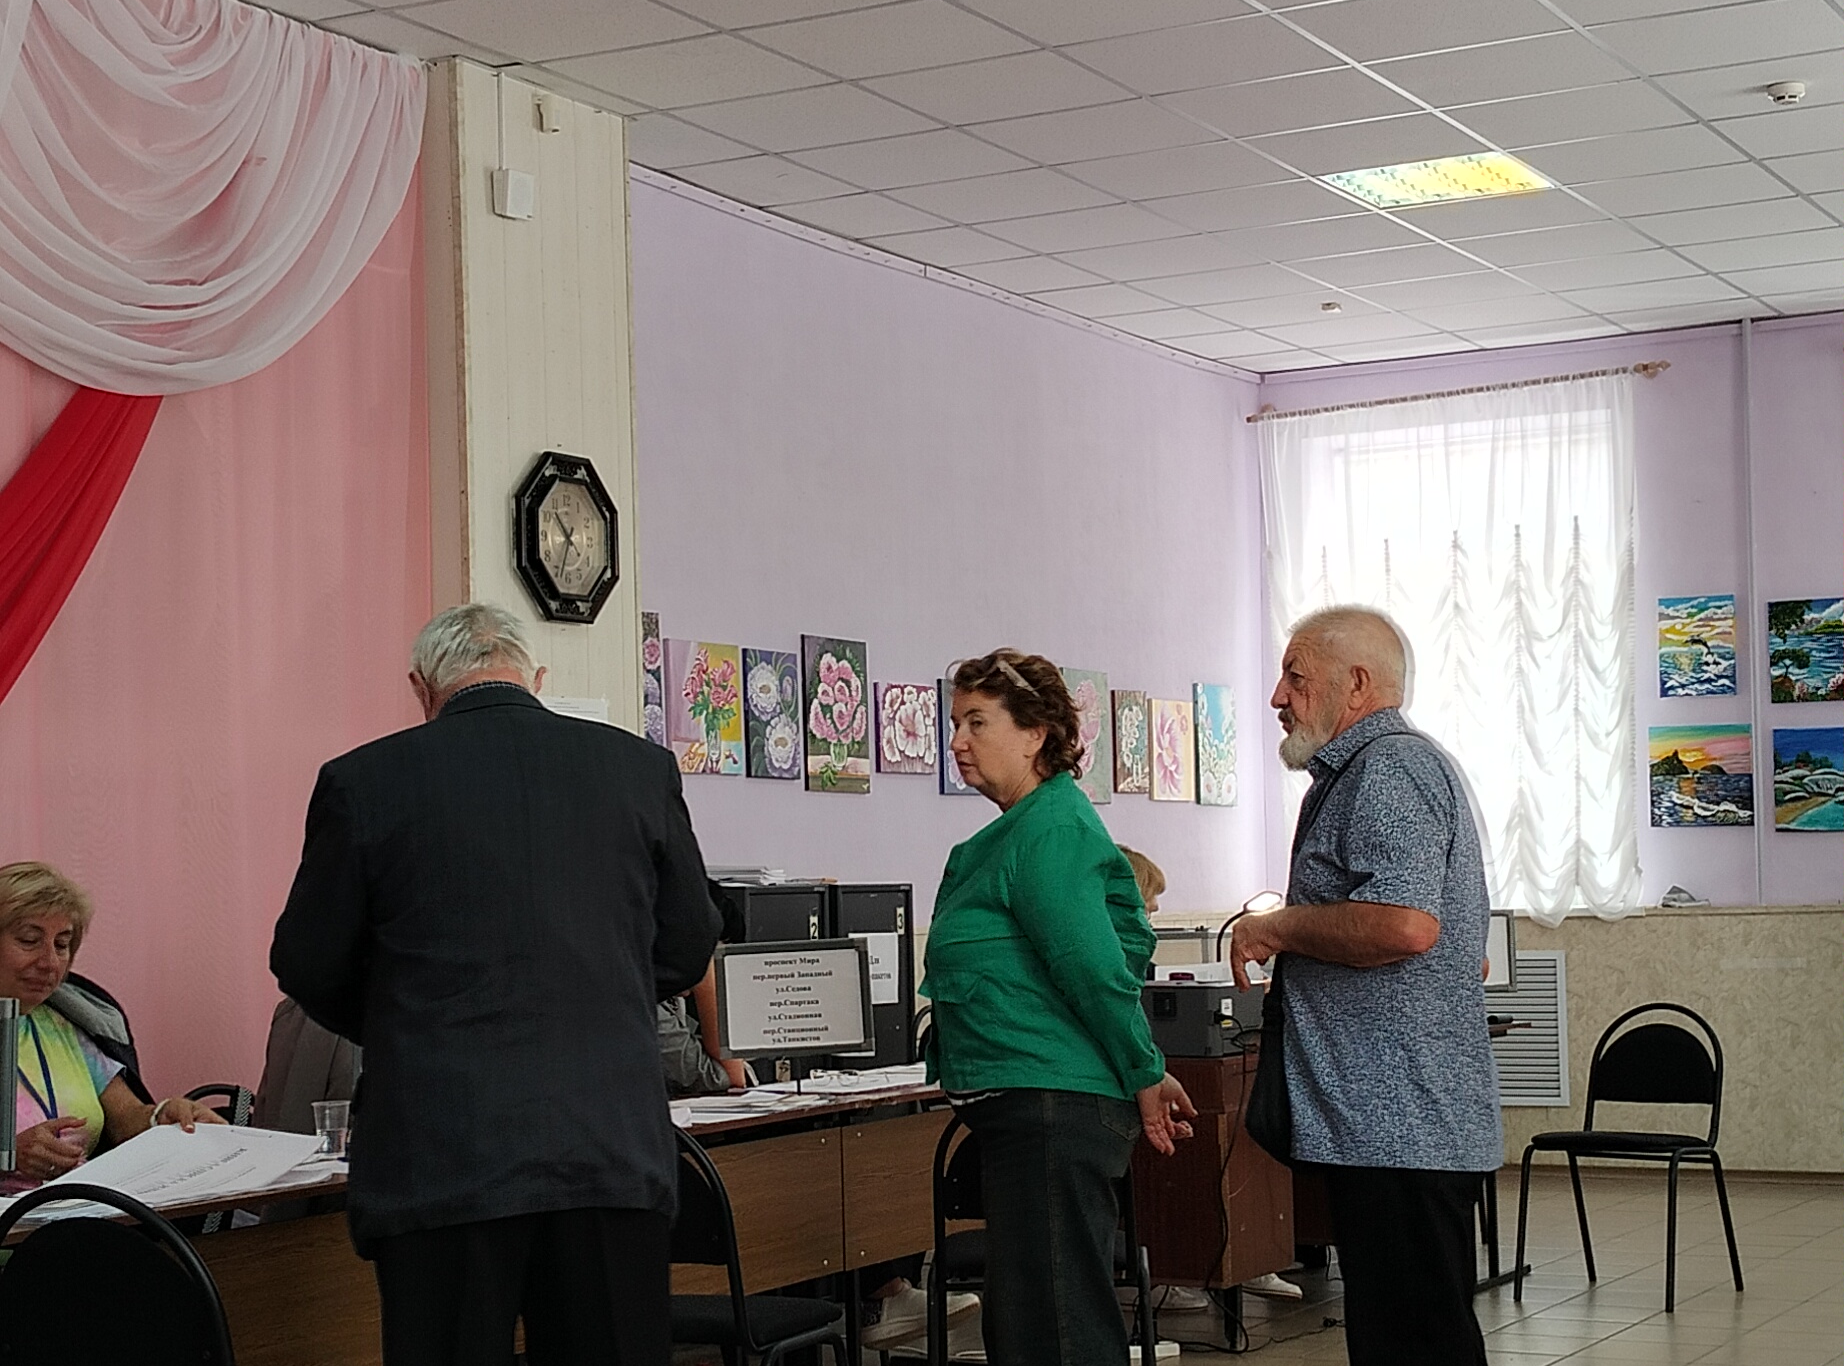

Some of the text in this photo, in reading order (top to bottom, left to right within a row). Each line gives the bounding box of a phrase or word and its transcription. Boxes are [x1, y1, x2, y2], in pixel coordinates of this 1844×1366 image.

[562, 494, 571, 506] 12
[583, 517, 590, 529] 2
[541, 529, 547, 542] 9
[544, 549, 551, 562] 8
[564, 572, 572, 584] 6
[897, 913, 904, 929] 3
[811, 922, 818, 939] 2
[764, 957, 820, 967] проспект Мира
[797, 970, 833, 979] Западный
